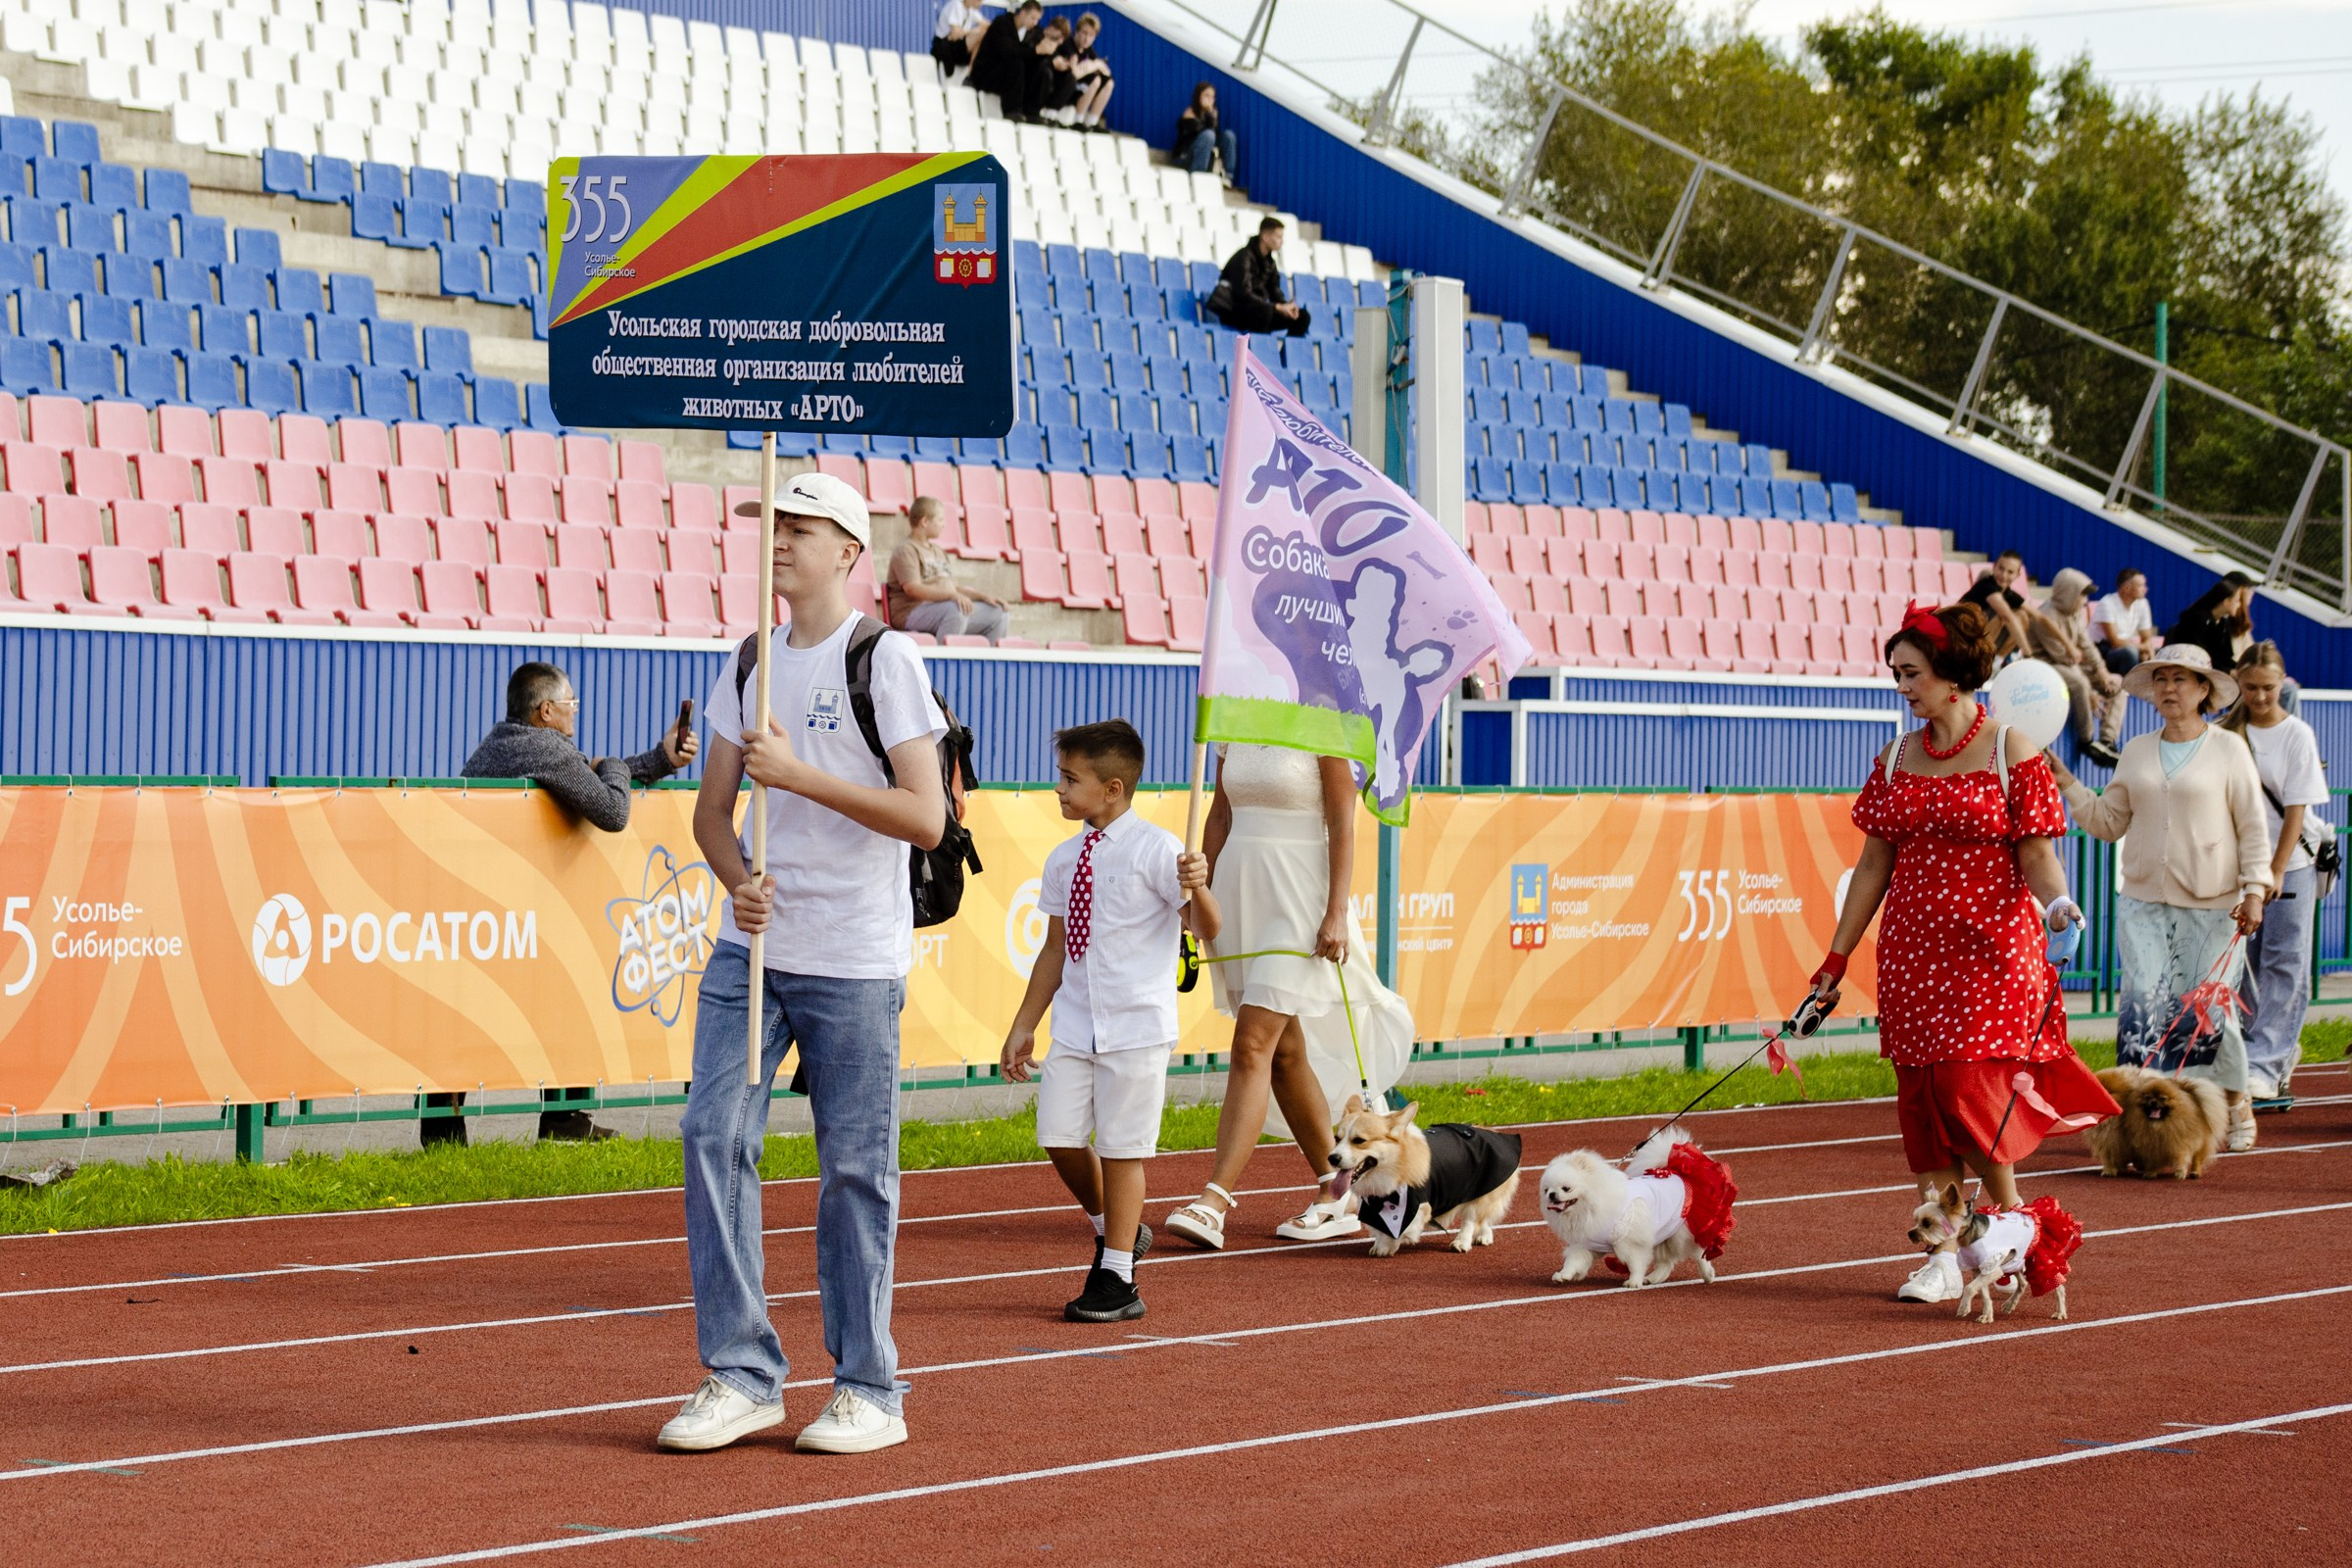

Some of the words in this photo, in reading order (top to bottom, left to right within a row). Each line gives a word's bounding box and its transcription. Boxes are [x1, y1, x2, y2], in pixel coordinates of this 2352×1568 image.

[561, 175, 632, 243] 355
[585, 251, 621, 264] Усолье-
[585, 265, 636, 280] Сибирское
[608, 310, 703, 337] Усольская
[709, 318, 803, 346] городская
[808, 310, 946, 349] добровольная
[592, 345, 716, 379] общественная
[723, 359, 846, 385] организация
[852, 351, 965, 384] любителей
[682, 397, 784, 421] животных
[791, 394, 864, 422] «АРТО»
[1551, 872, 1635, 892] Администрация
[52, 896, 143, 923] Усолье-
[1408, 893, 1454, 918] ГРУП
[1551, 900, 1589, 917] города
[1678, 869, 1733, 942] 355
[1738, 870, 1784, 890] Усолье-
[1738, 895, 1802, 917] Сибирское
[619, 880, 708, 960] АТОМ
[1551, 919, 1650, 940] Усолье-Сибирское
[51, 930, 182, 965] Сибирское
[322, 909, 538, 964] РОСАТОМ
[1426, 938, 1453, 952] ЦЕНТР
[623, 920, 708, 995] ФЕСТ
